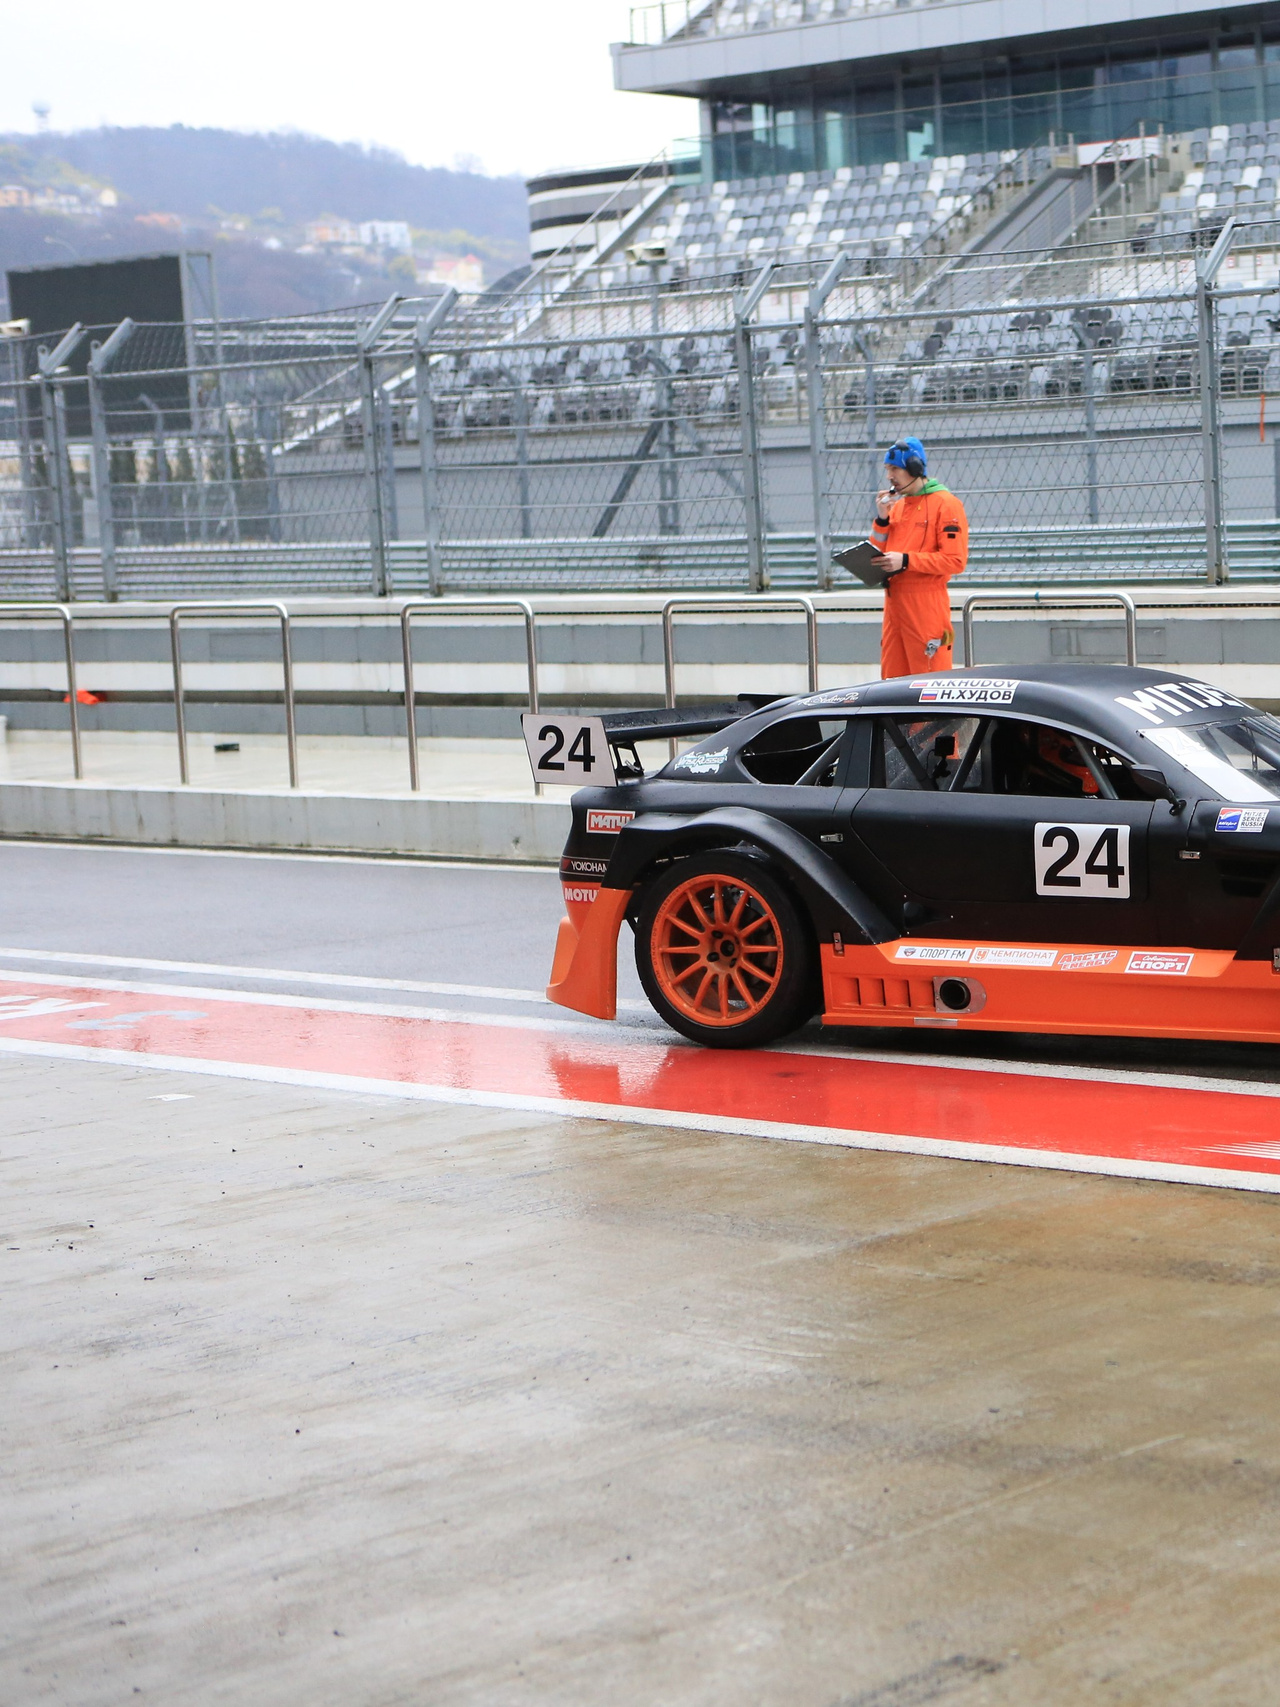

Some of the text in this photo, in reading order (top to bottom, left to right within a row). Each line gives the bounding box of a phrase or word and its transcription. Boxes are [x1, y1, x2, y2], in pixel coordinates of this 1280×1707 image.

[930, 679, 1017, 688] N.KHUDOV
[940, 689, 1013, 702] Н.ХУДОВ
[537, 724, 596, 773] 24
[1042, 826, 1125, 889] 24
[919, 948, 966, 959] СПОРТ FM
[991, 950, 1054, 959] ЧЕМПИОНАТ
[1060, 951, 1116, 964] ARCTIC
[1061, 957, 1112, 970] ENERGY
[1130, 961, 1185, 970] СПОРТ
